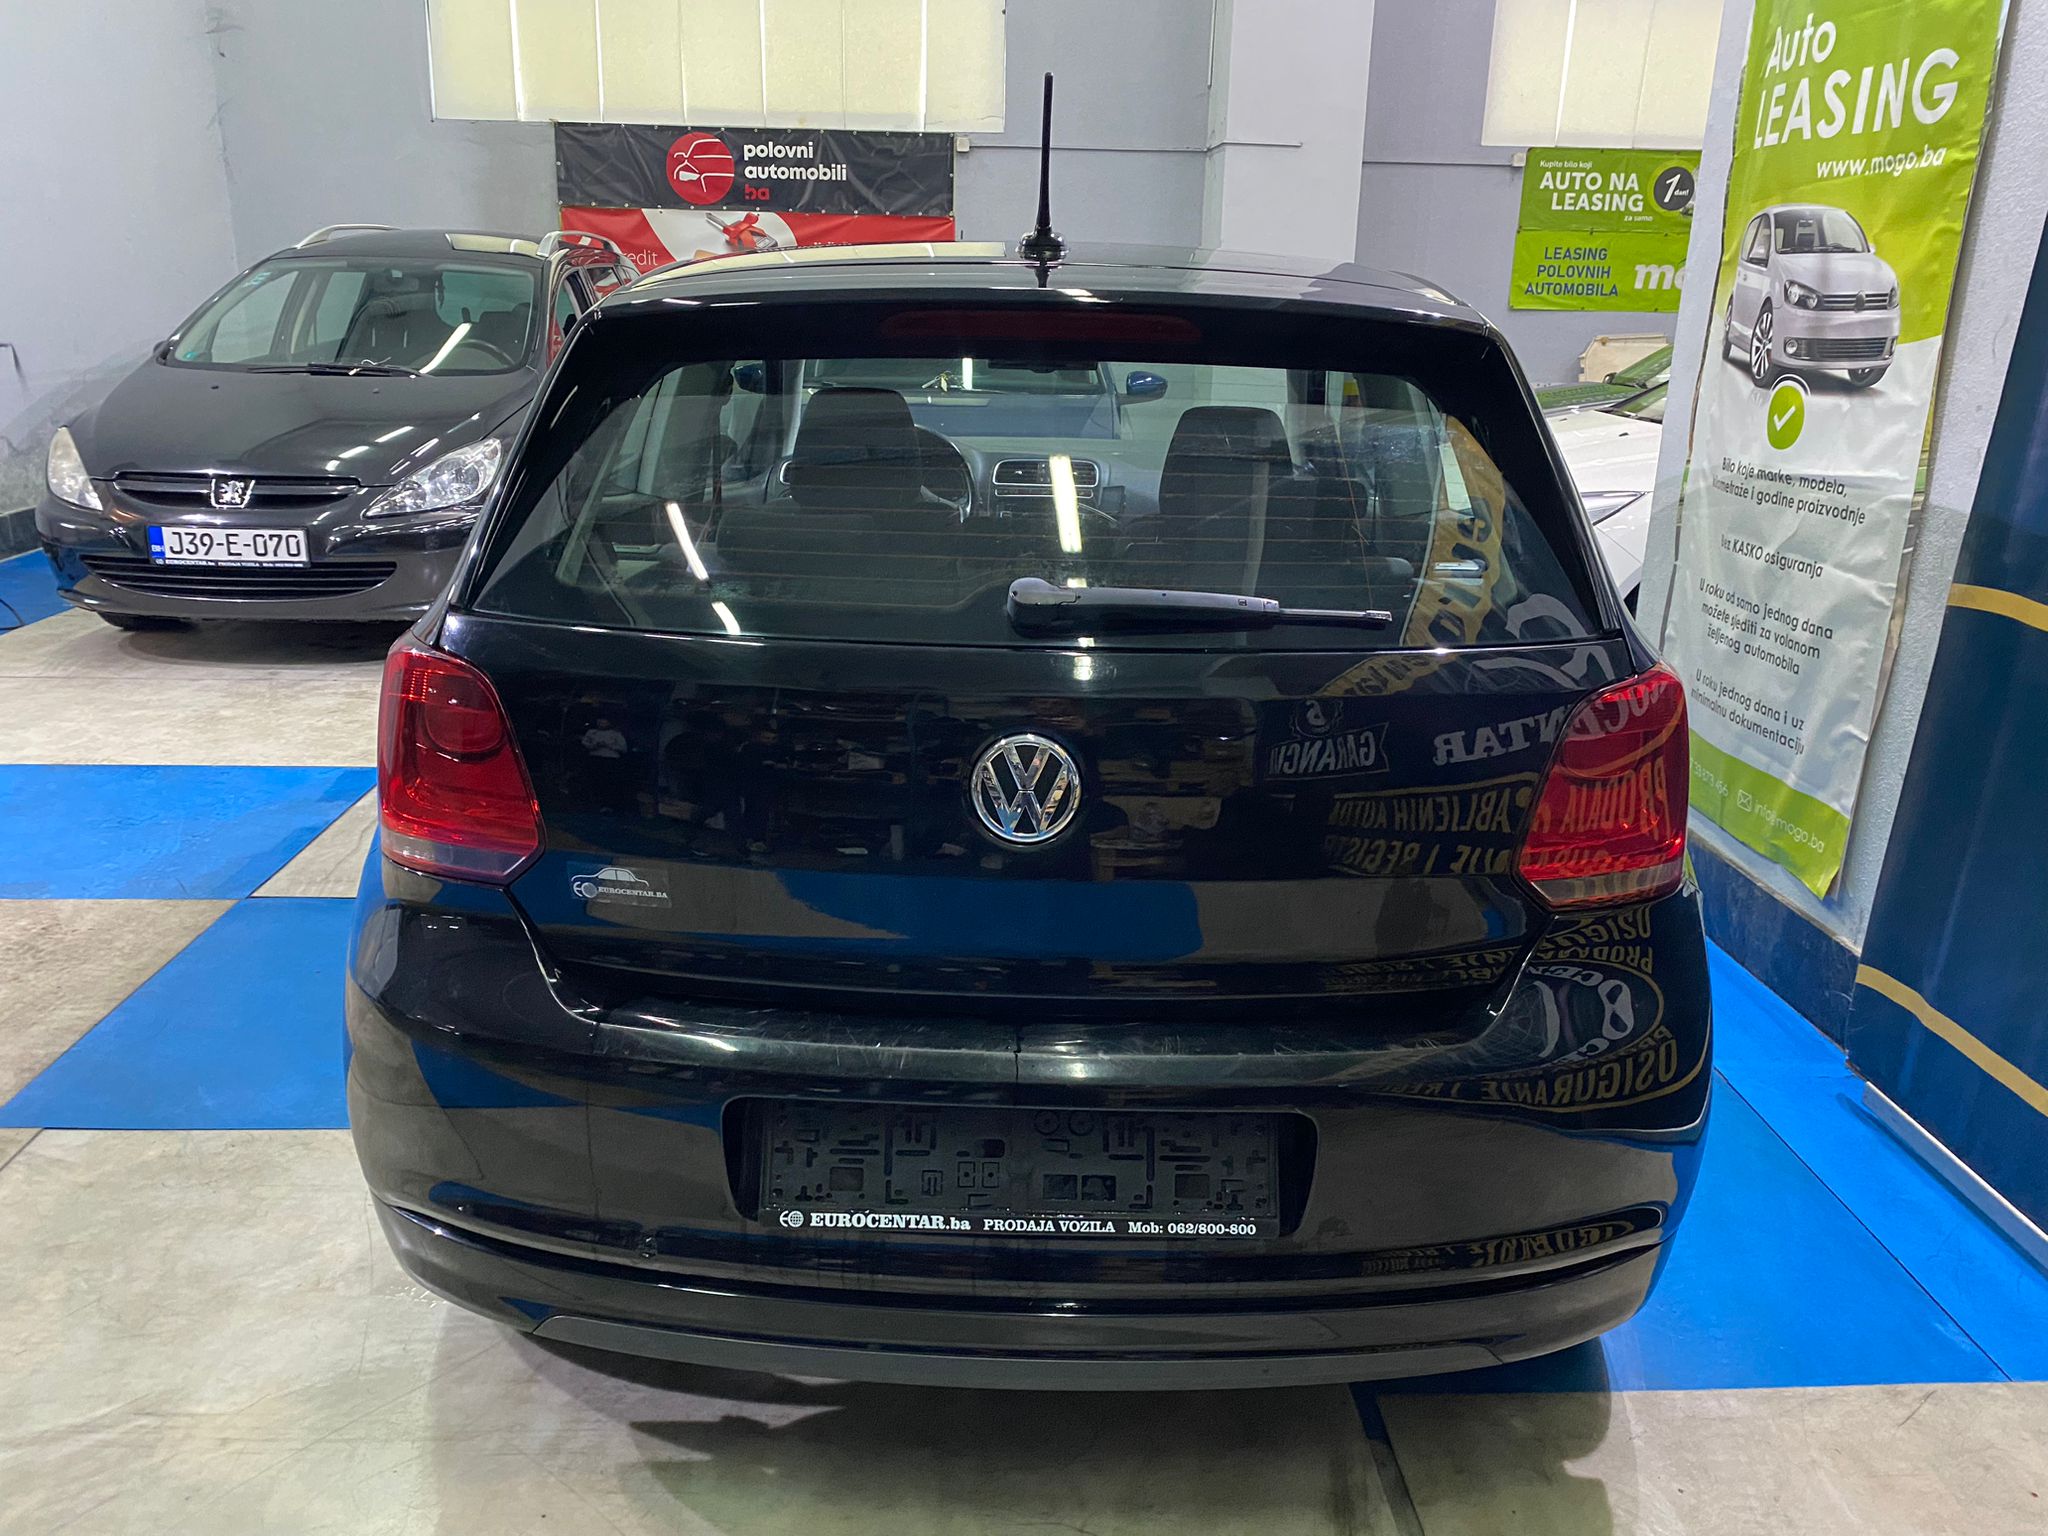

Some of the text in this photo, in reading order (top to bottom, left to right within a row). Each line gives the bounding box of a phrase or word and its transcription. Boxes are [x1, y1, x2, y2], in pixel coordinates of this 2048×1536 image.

[1765, 12, 1836, 79] Auto
[1753, 48, 1960, 150] LEASING
[743, 142, 814, 161] polovni
[1539, 160, 1593, 170] Kupite bilo koji
[1816, 144, 1947, 179] www.mogo.ba
[744, 161, 847, 182] automobili
[1539, 172, 1639, 191] AUTO NA
[745, 185, 770, 201] ba
[1663, 173, 1681, 203] 1
[1551, 193, 1644, 213] LEASING
[623, 249, 659, 266] edit
[1544, 247, 1608, 261] LEASING
[1536, 264, 1611, 279] POLOVNIH
[1524, 282, 1619, 297] AUTOMOBILA
[1736, 460, 1755, 480] koje
[1757, 468, 1796, 487] marke,
[1799, 475, 1848, 498] modela,
[1750, 486, 1755, 500] i
[1756, 489, 1795, 509] godine
[1796, 498, 1866, 527] proizvodnje
[169, 531, 301, 558] J39-E-070
[1732, 538, 1764, 561] KASKO
[1764, 551, 1824, 580] osiguranja
[1700, 578, 1834, 640] U roku od samo jednog dana
[1702, 601, 1821, 659] možete sjediti za volanom
[1707, 623, 1800, 675] željenog automobila
[1696, 668, 1805, 731] U roku jednog dana i uz
[1690, 686, 1805, 755] minimalnu dokumentaciju
[598, 886, 669, 899] EUROCENTAR.BA
[809, 1210, 1257, 1237] EUROCENTAR.ba PRODAJA VOZILA Mob: 062/800-800
